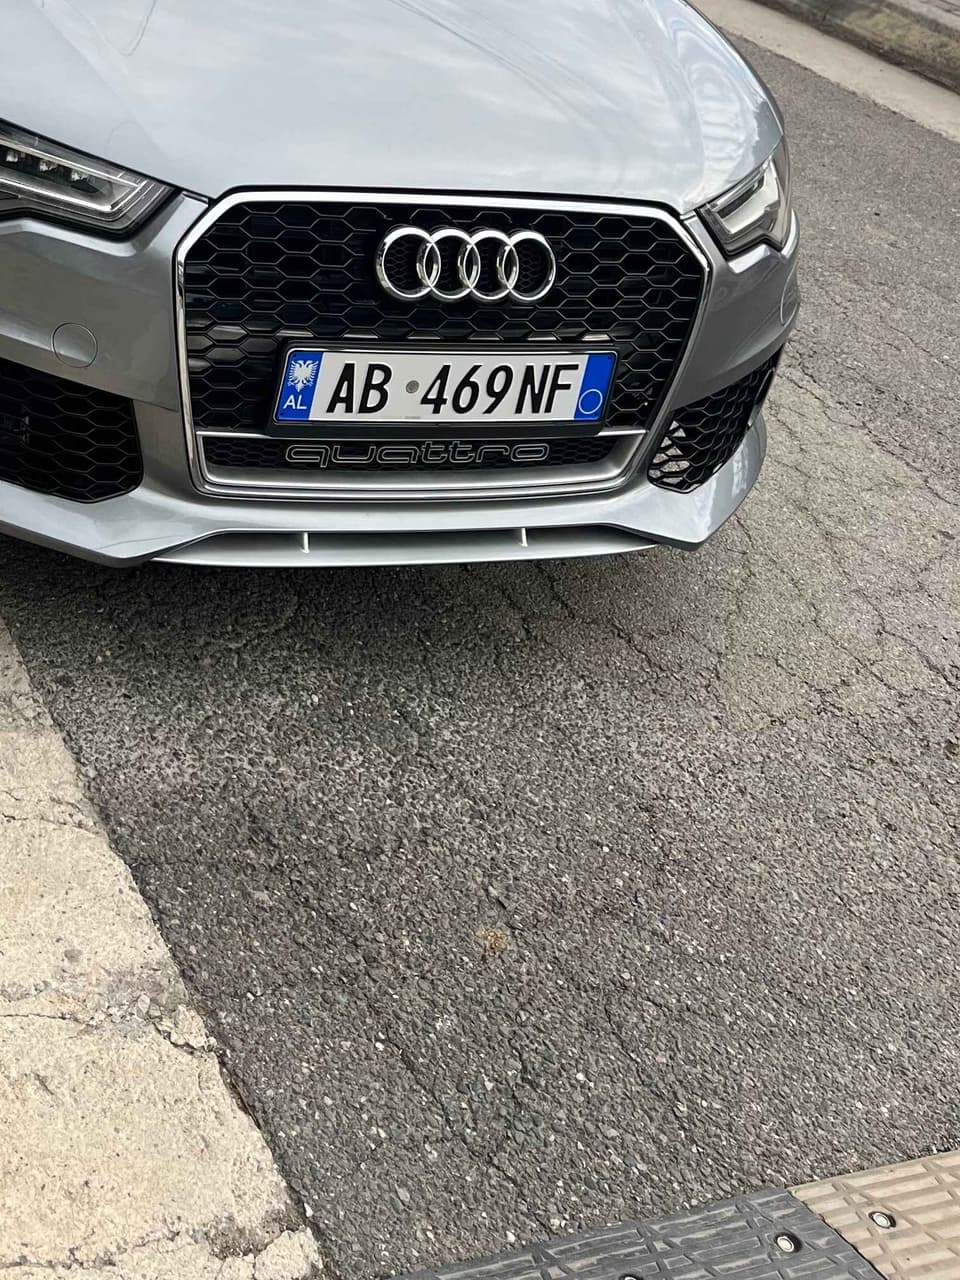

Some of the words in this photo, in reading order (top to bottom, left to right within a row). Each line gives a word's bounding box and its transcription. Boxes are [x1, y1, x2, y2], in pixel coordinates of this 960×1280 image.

[283, 394, 308, 410] AL
[326, 362, 393, 414] AB
[421, 363, 579, 415] 469NF
[285, 441, 550, 468] quattro
